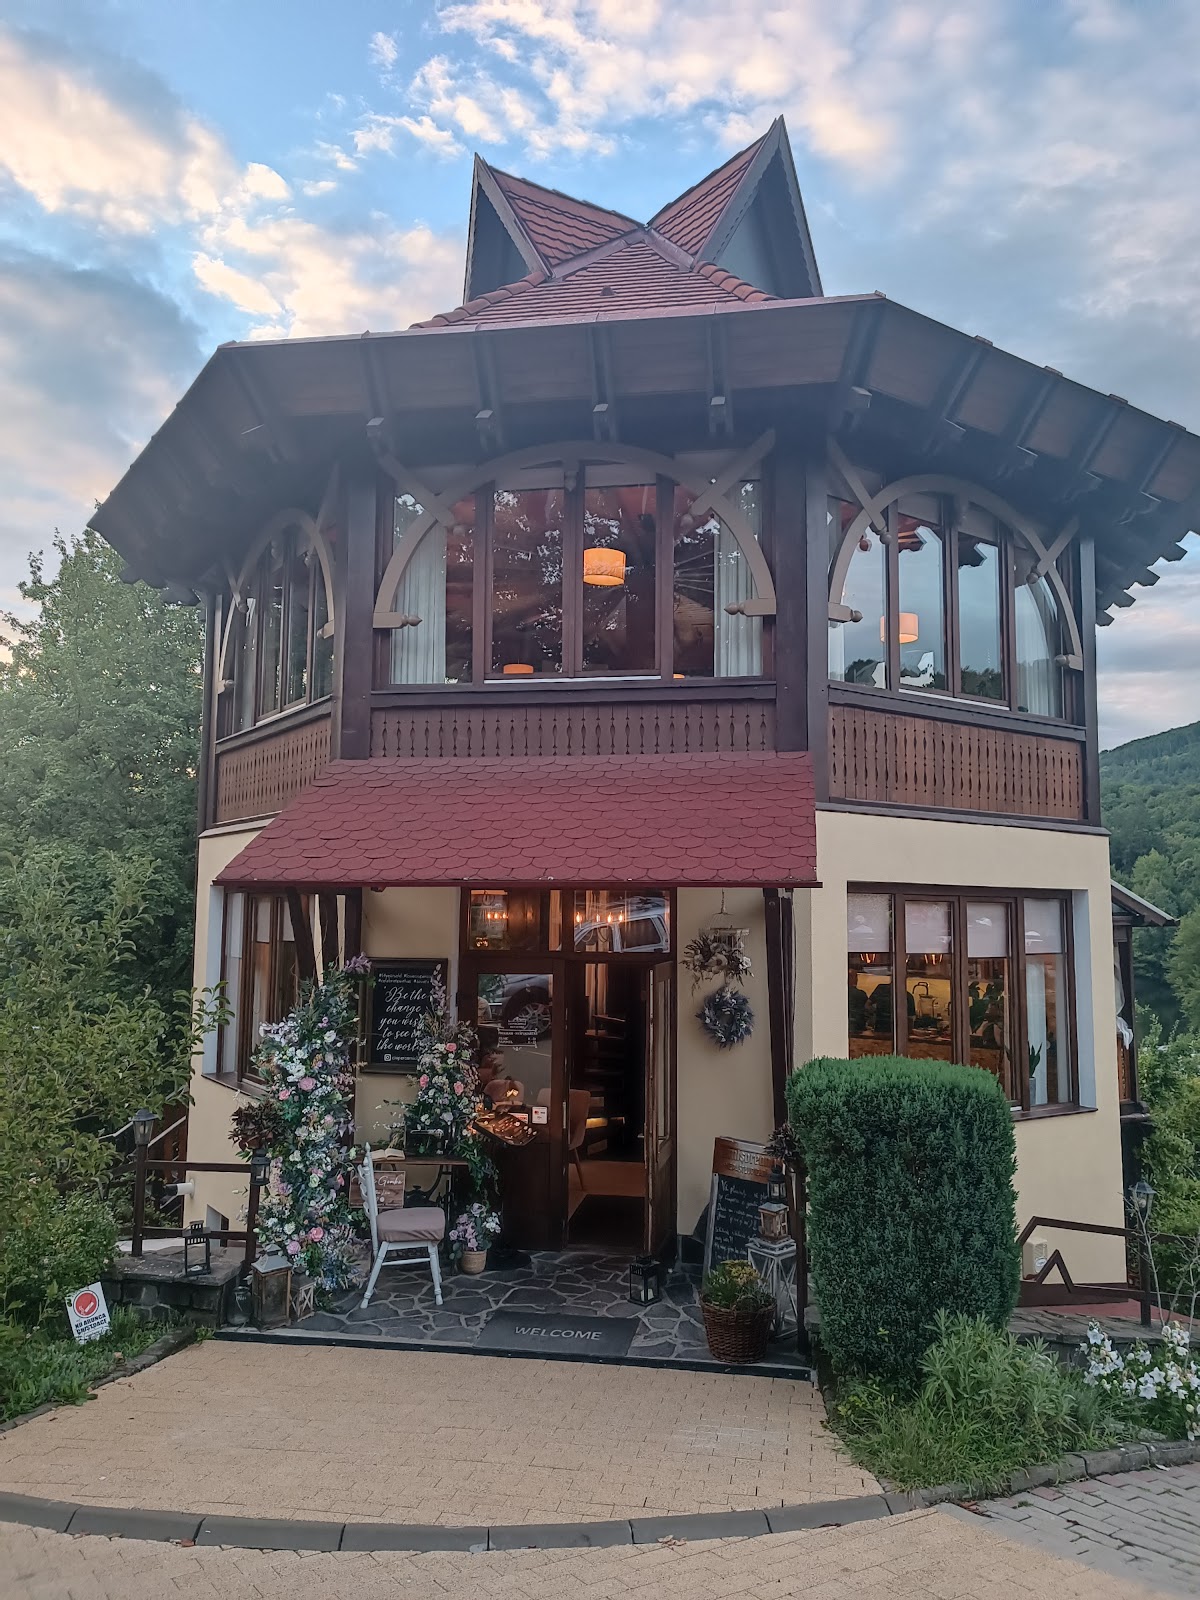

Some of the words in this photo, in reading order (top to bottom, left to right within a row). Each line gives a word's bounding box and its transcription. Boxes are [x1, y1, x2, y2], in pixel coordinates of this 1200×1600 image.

[386, 1001, 421, 1018] change
[378, 1017, 400, 1031] you
[376, 1038, 394, 1051] the
[515, 1326, 602, 1340] WELCOME
